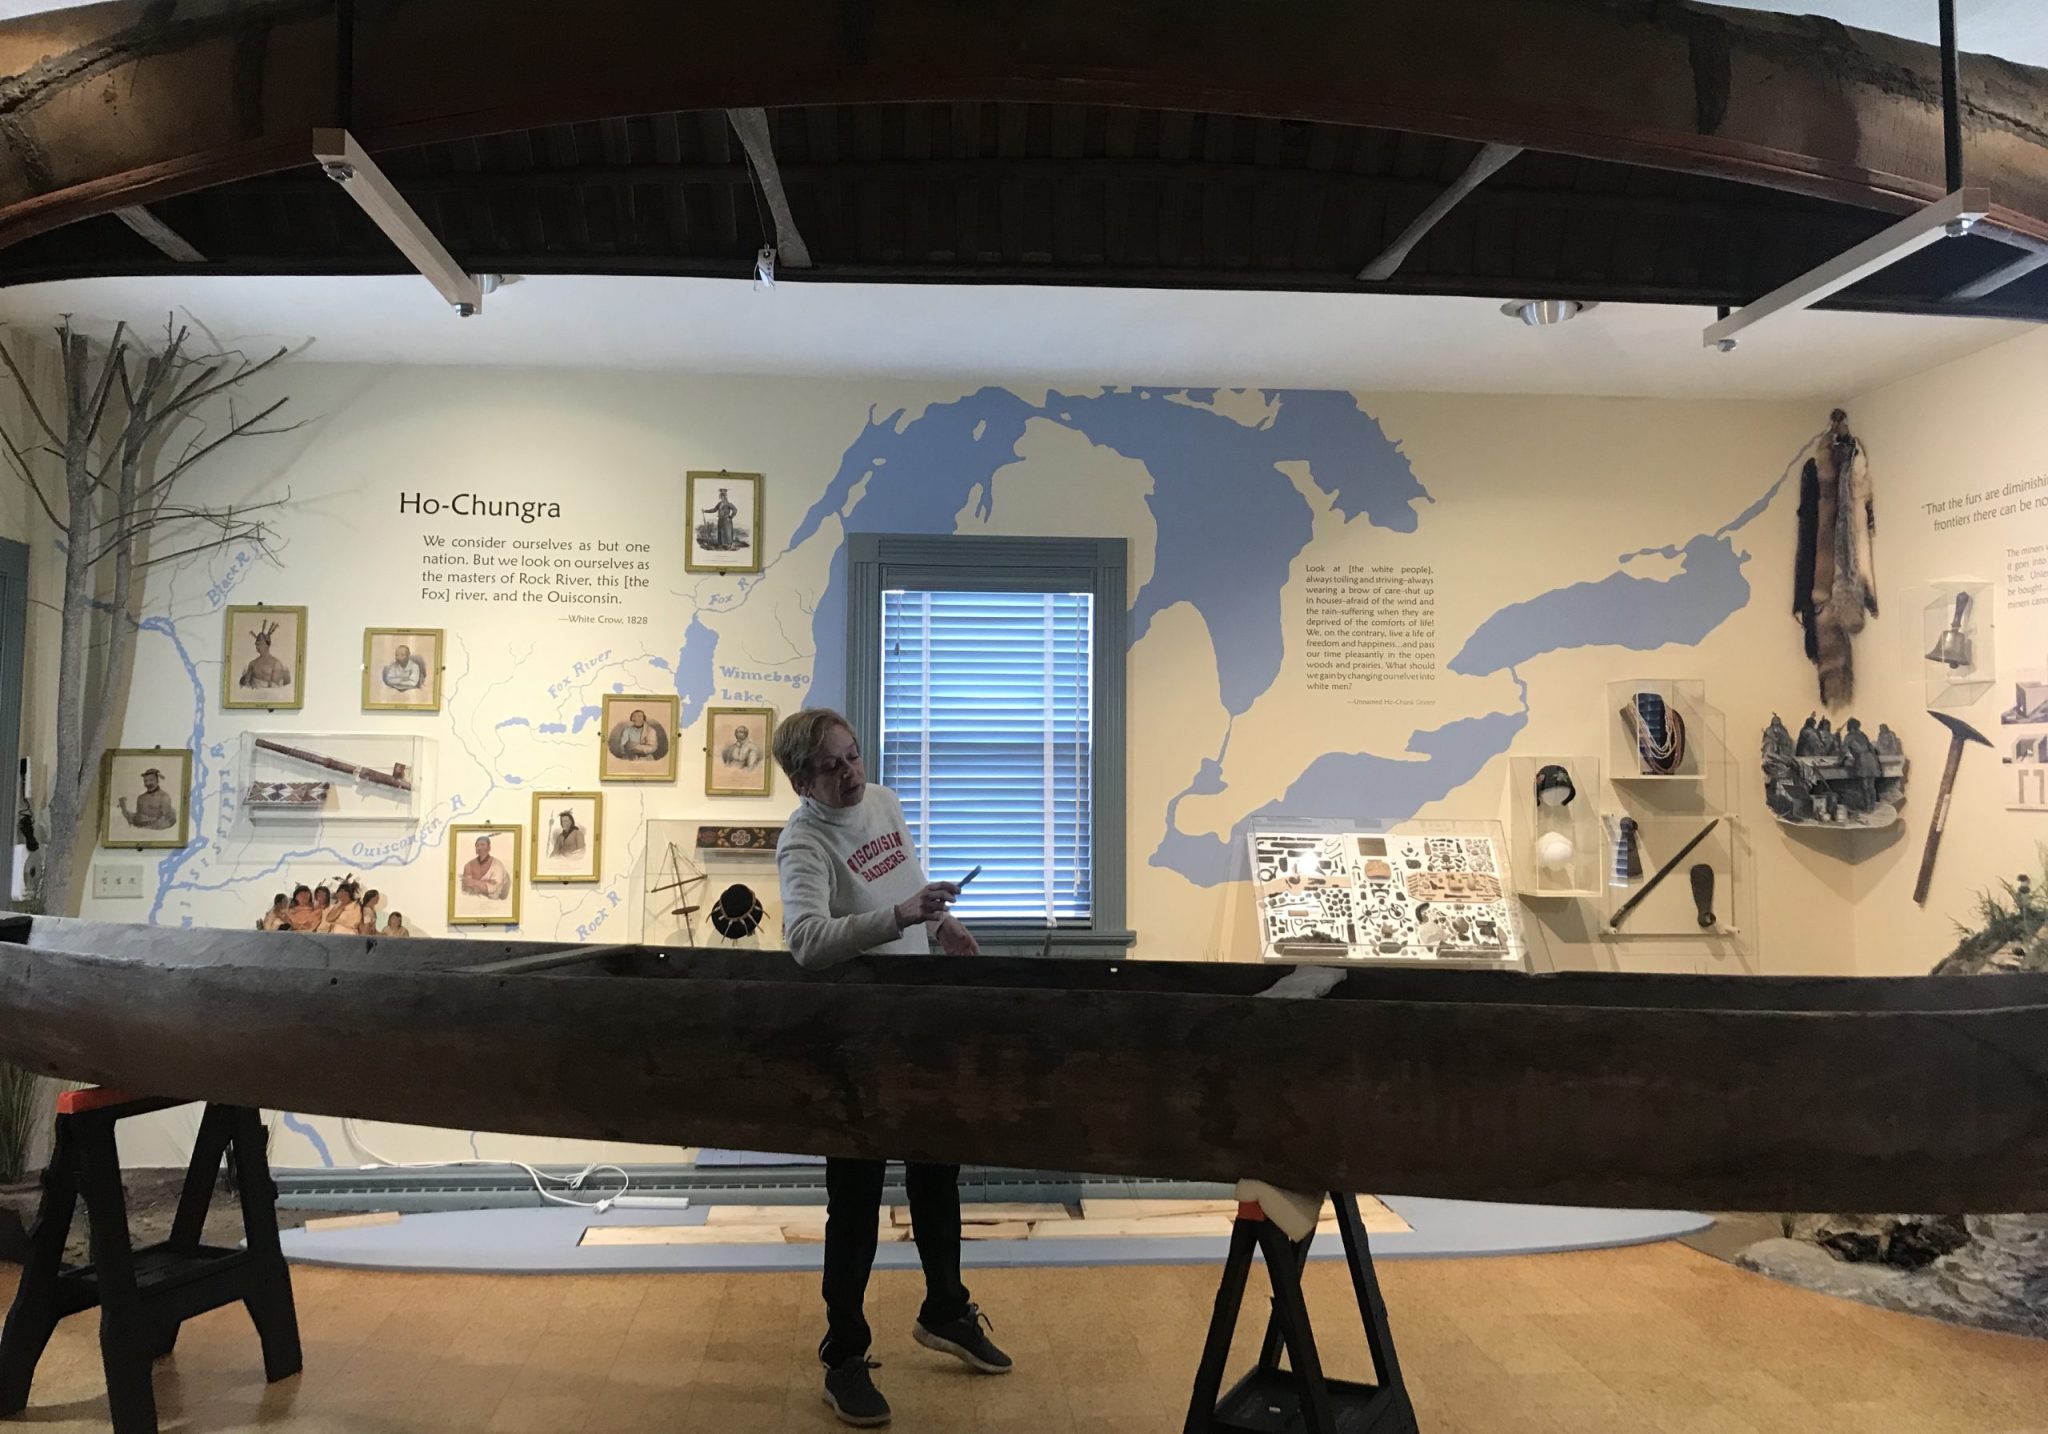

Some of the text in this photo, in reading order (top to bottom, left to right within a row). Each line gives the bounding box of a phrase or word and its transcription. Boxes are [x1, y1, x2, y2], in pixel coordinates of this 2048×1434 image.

[399, 491, 562, 524] Ho-Chungra
[1948, 497, 1963, 510] the
[1966, 493, 1982, 505] furs
[1985, 489, 2000, 501] are
[1934, 514, 1970, 531] frontiers
[1974, 509, 1997, 522] there
[2000, 504, 2016, 516] can
[2020, 499, 2032, 511] be
[424, 535, 650, 552] We consider ourselves as but one
[423, 554, 650, 570] nation. But we look on ourselves as
[1372, 565, 1393, 573] white
[206, 552, 250, 607] Black R
[422, 570, 443, 582] the
[447, 572, 496, 583] masters
[500, 573, 515, 584] of
[519, 572, 551, 584] Rock
[597, 575, 619, 587] this
[624, 575, 649, 589] [the
[1306, 576, 1332, 584] always
[422, 588, 450, 602] Fox]
[492, 590, 517, 602] and
[522, 590, 543, 602] the
[547, 591, 622, 604] Ouisconsin.
[708, 578, 749, 605] Fox R
[1306, 587, 1337, 595] wearing
[627, 616, 648, 625] 1828
[1402, 609, 1419, 617] they
[1306, 618, 1341, 627] deprived
[1409, 619, 1417, 627] of
[1345, 651, 1383, 659] pleasantly
[548, 650, 612, 698] Fox River
[1409, 662, 1435, 670] should
[720, 666, 810, 688] Winnebago
[1320, 672, 1336, 680] gain
[1337, 672, 1347, 680] by
[1348, 672, 1382, 681] changing
[721, 689, 763, 702] Lake
[352, 794, 465, 856] Ouisconsin R
[861, 850, 906, 882] BADGERS
[576, 890, 622, 942] Rock R
